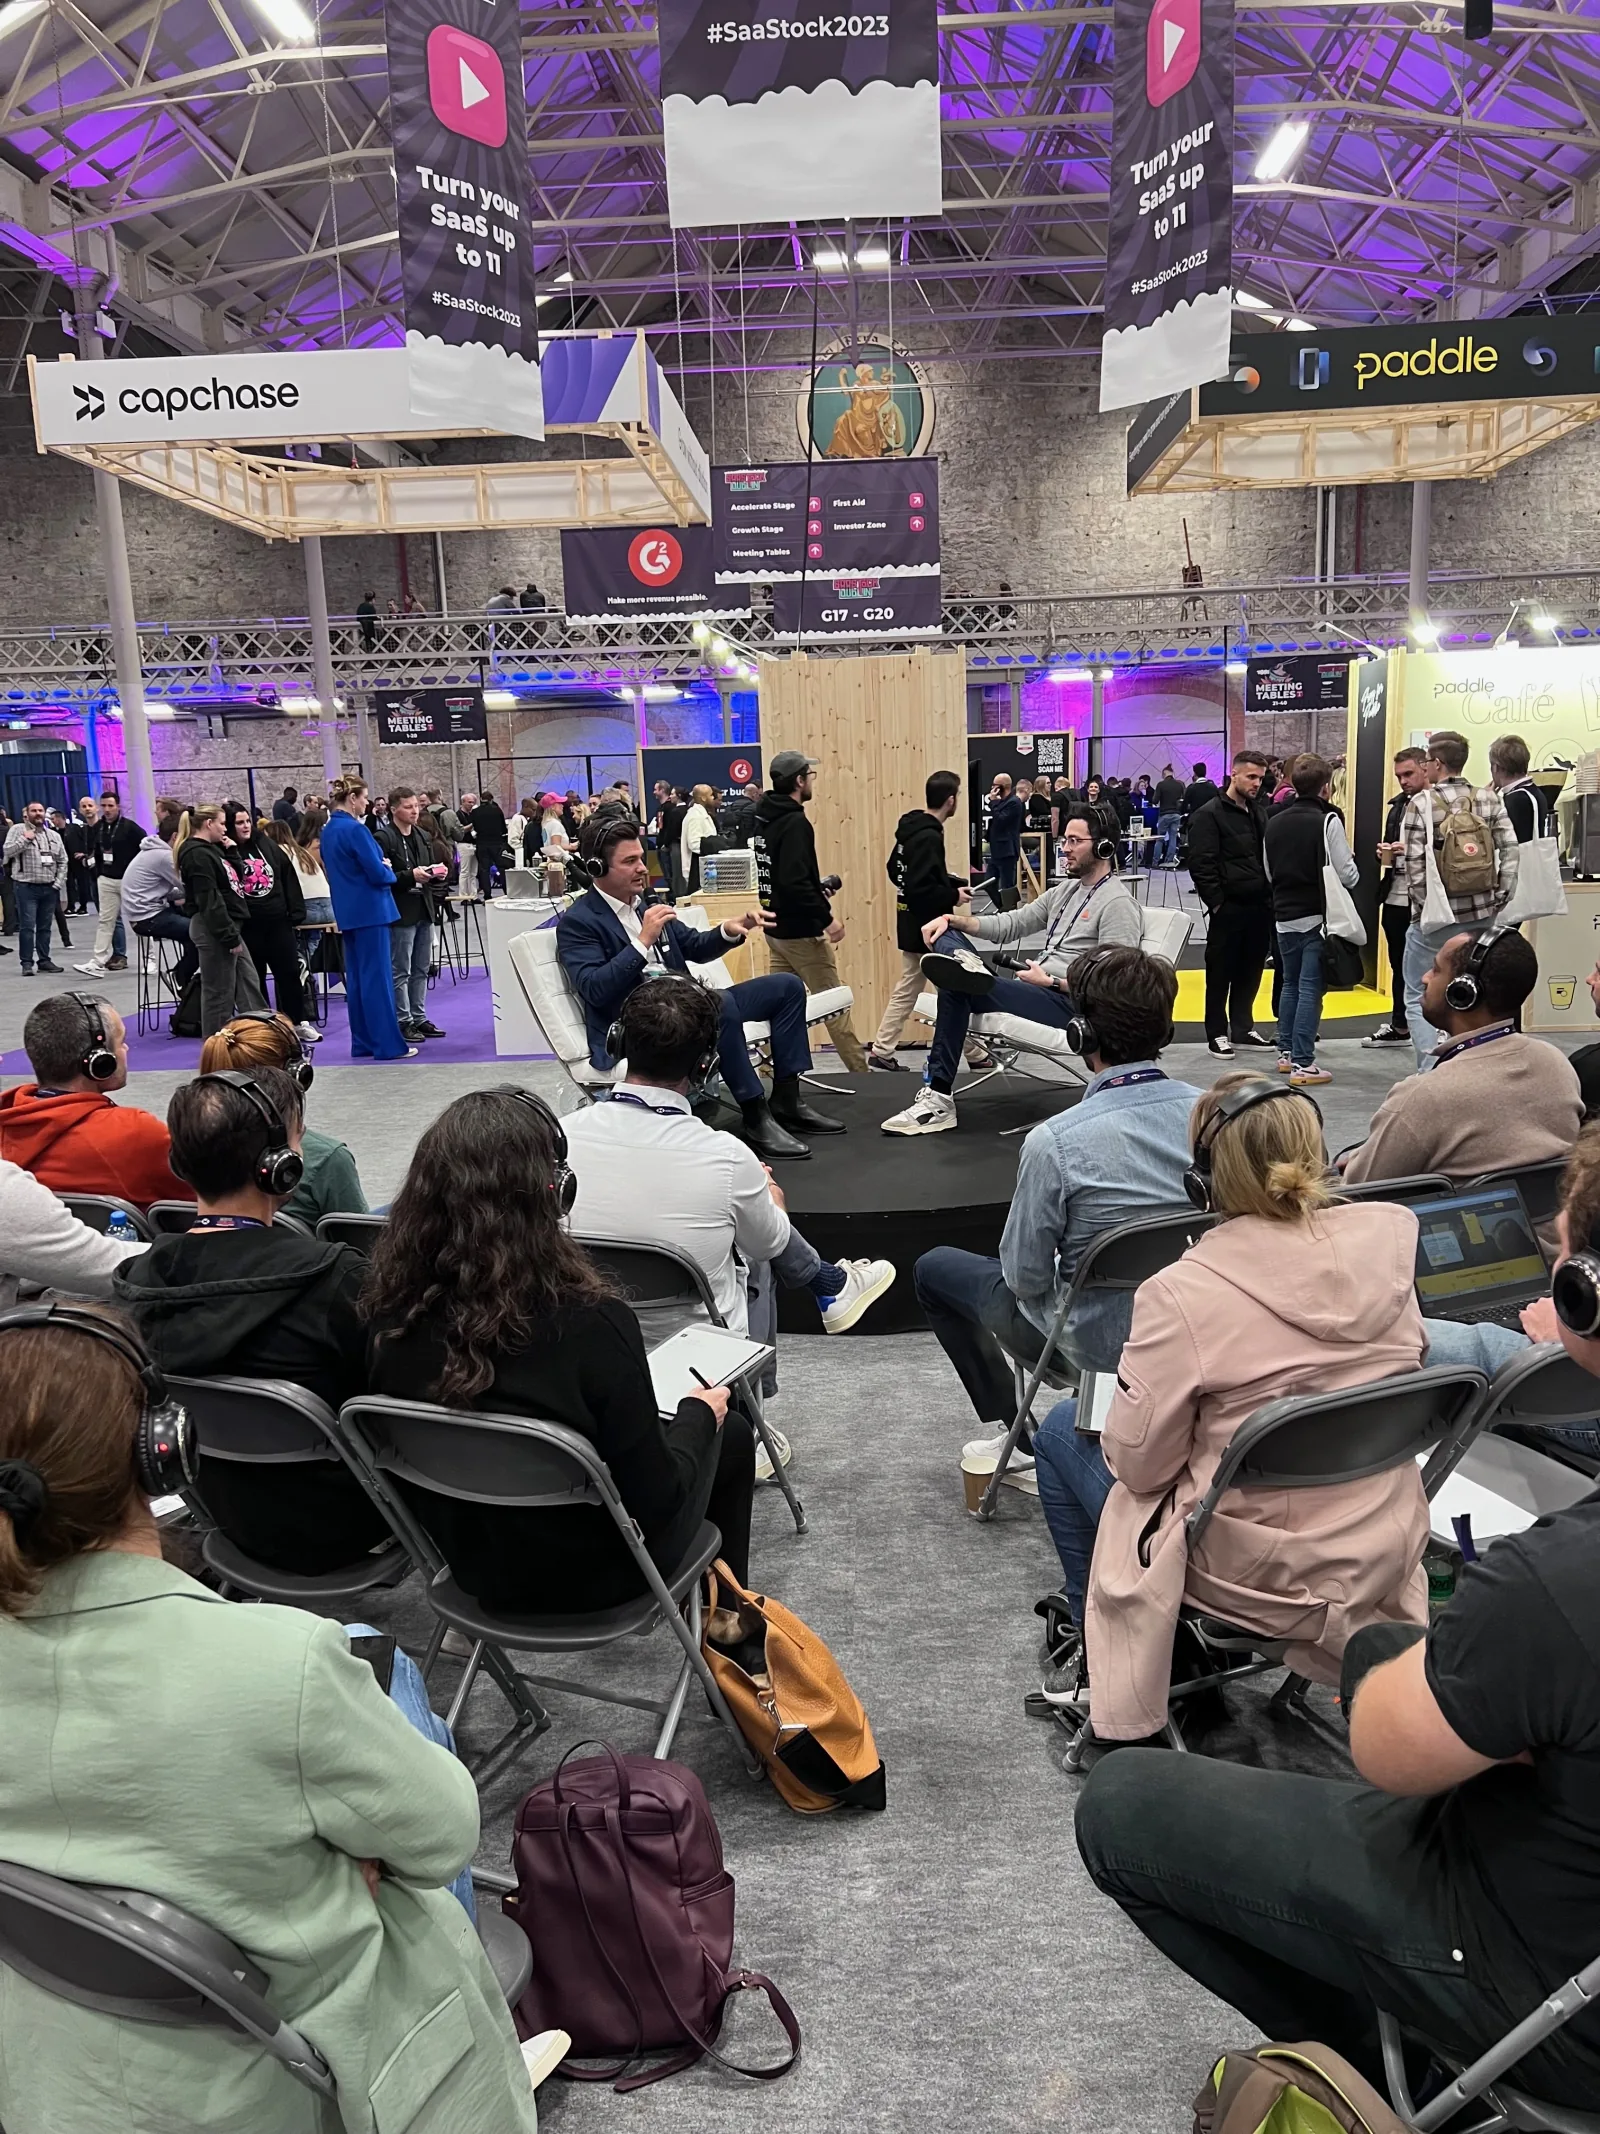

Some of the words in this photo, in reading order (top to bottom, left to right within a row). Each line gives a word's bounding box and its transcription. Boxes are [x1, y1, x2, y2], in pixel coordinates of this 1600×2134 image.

[707, 15, 890, 44] #SaaStock2023
[1130, 149, 1168, 185] Turn
[1171, 121, 1214, 167] your
[416, 165, 475, 201] Turn
[479, 187, 520, 220] your
[1138, 174, 1176, 216] SaaS
[1180, 163, 1205, 190] up
[430, 203, 489, 238] SaaS
[492, 225, 516, 253] up
[1154, 217, 1169, 240] to
[1172, 202, 1187, 229] 11
[455, 243, 482, 267] to
[485, 250, 501, 275] 11
[1130, 249, 1209, 296] #SaaStock2023
[431, 290, 522, 328] #SaaStock2023
[1353, 336, 1499, 390] paddle
[118, 377, 299, 421] capchase
[731, 503, 771, 511] Accelerate
[773, 502, 796, 510] Stage
[833, 499, 851, 507] First
[852, 498, 866, 507] Aid
[732, 526, 760, 534] Growth
[761, 525, 784, 534] Stage
[834, 523, 865, 531] Investor
[866, 521, 886, 529] Zone
[732, 549, 764, 558] Meeting
[765, 548, 790, 557] Tables
[676, 593, 708, 603] possible.
[821, 609, 849, 622] G17
[863, 608, 894, 620] G20
[1256, 682, 1302, 692] MEETING
[1256, 691, 1296, 700] TABLES
[1433, 678, 1495, 699] paddle
[1462, 683, 1555, 725] Café
[387, 716, 433, 725] MEETING
[388, 724, 427, 732] TABLES
[1054, 765, 1063, 773] ME
